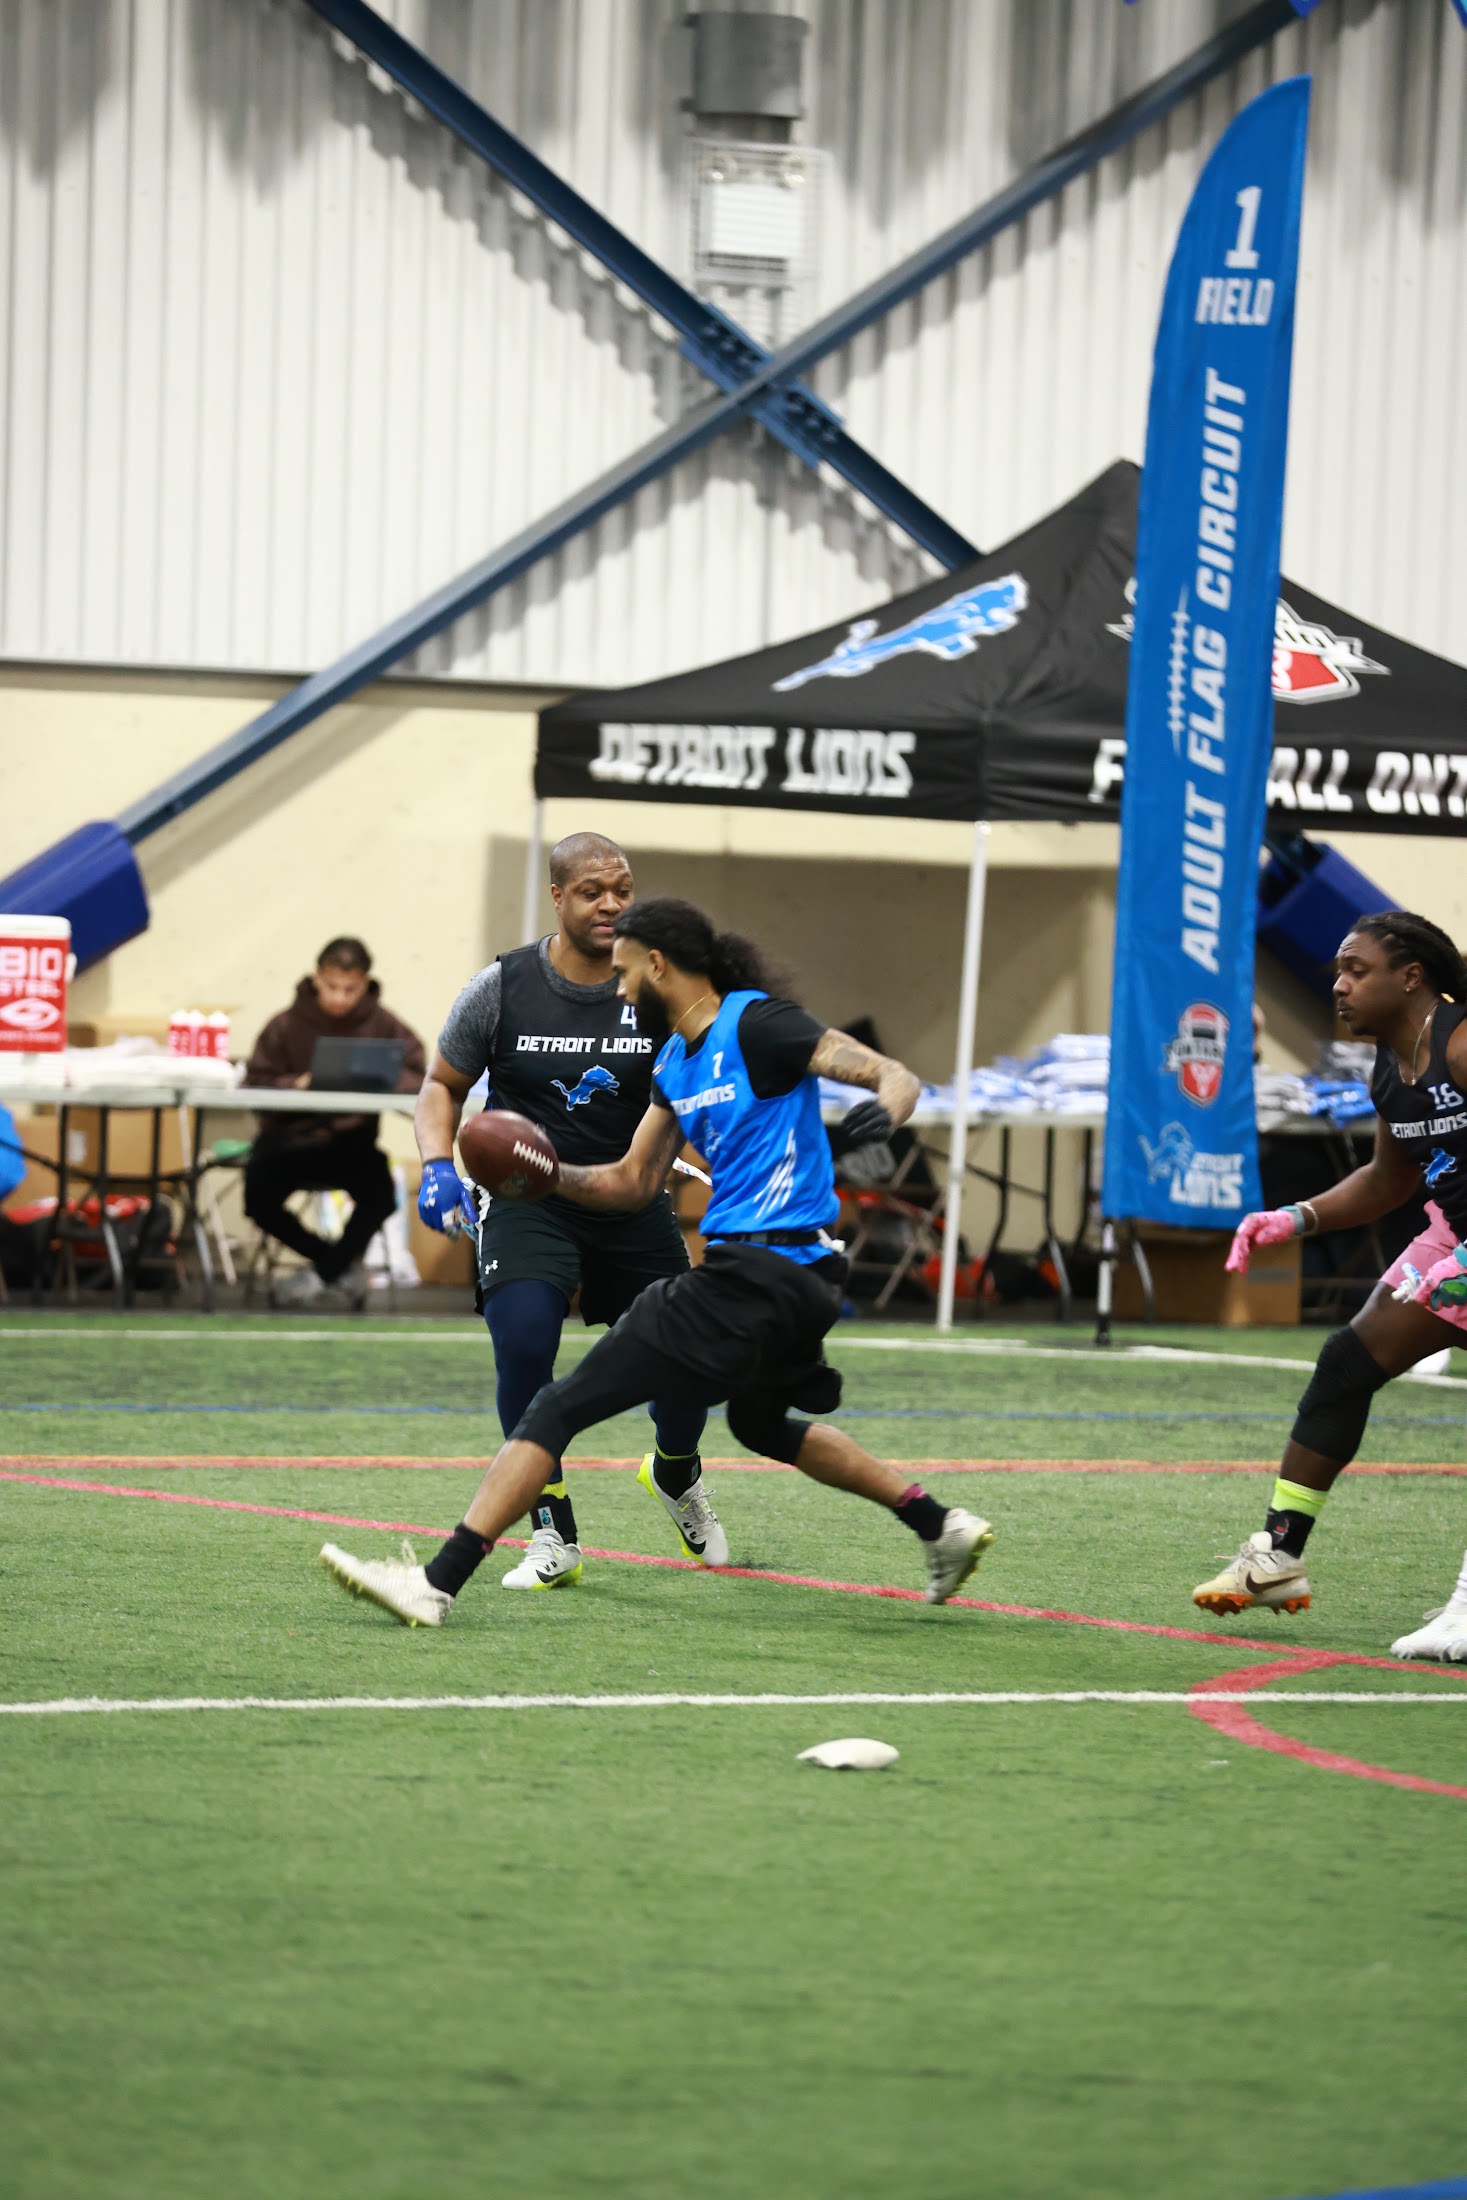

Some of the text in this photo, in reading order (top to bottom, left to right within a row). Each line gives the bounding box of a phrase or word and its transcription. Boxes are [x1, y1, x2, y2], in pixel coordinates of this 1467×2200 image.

[1225, 185, 1262, 269] 1
[1194, 276, 1275, 326] FIELD
[1181, 366, 1247, 976] ADULT FLAG CIRCUIT
[588, 722, 917, 798] DETROIT LIONS
[1088, 738, 1354, 813] FALL
[0, 946, 63, 981] BIO
[620, 1004, 637, 1030] 4
[516, 1034, 652, 1054] DETROIT LIONS
[712, 1050, 724, 1079] 1
[1427, 1111, 1467, 1136] LIONS
[1168, 1170, 1243, 1210] LIONS
